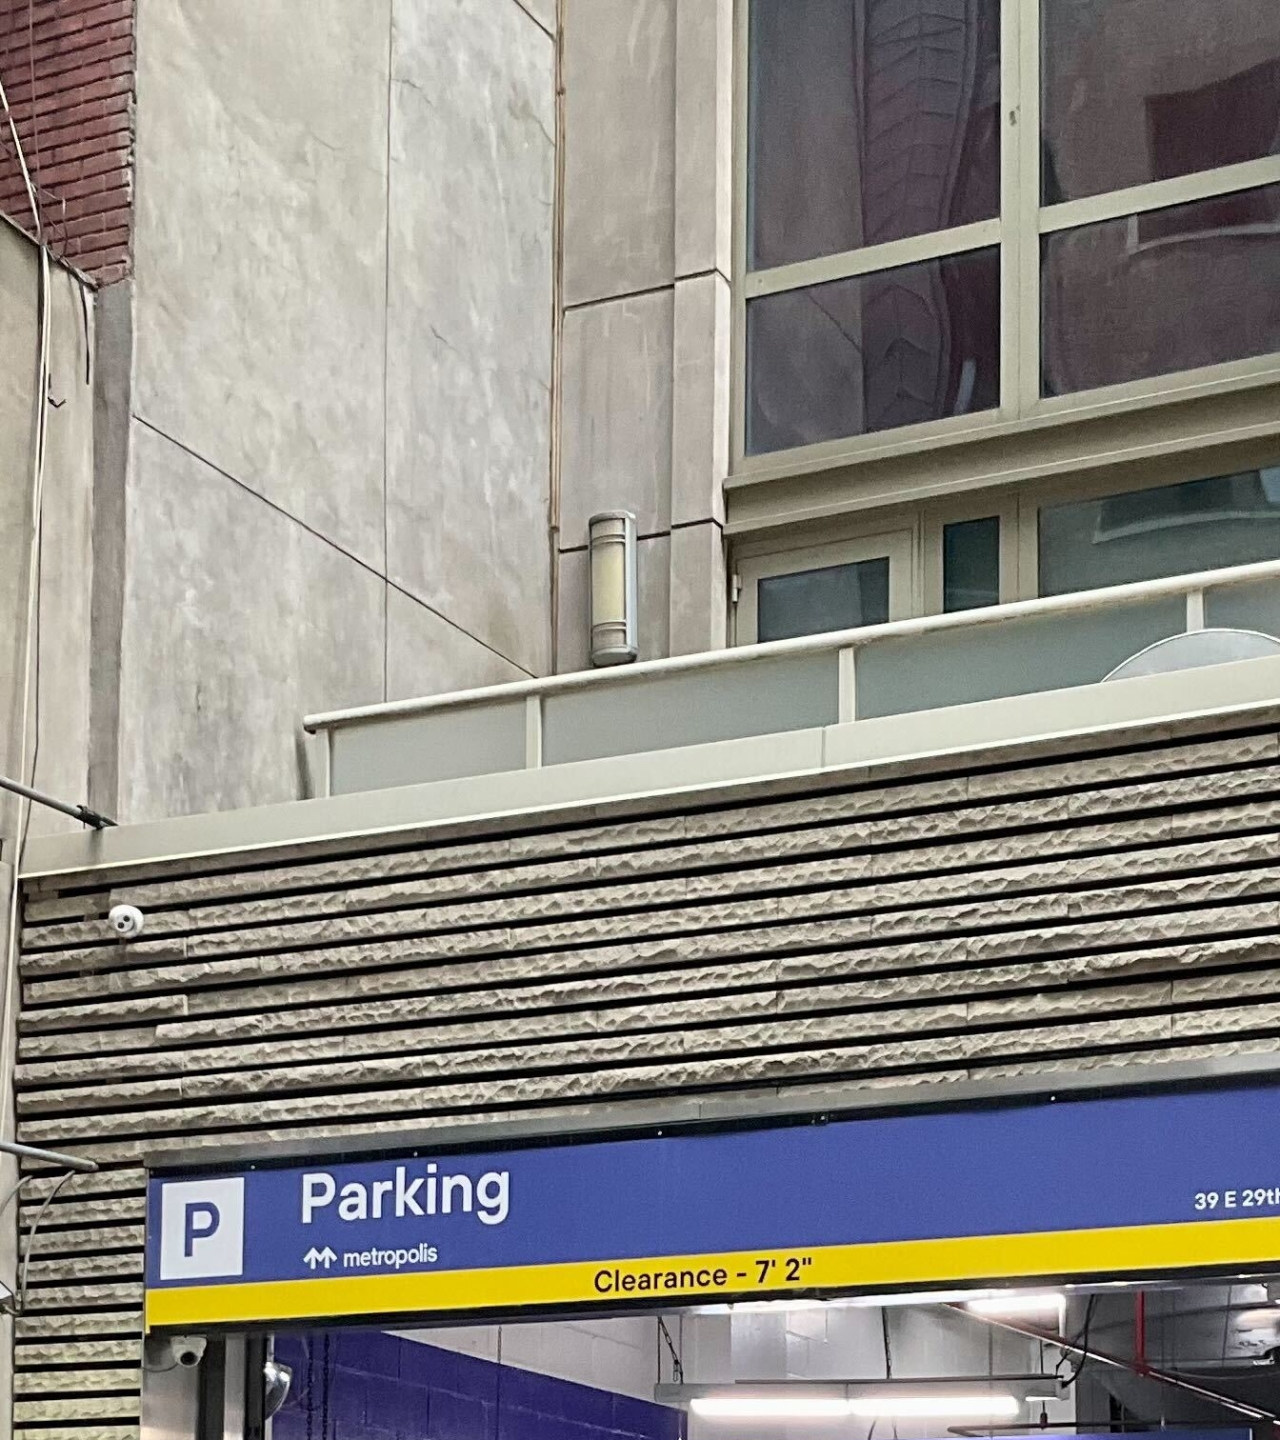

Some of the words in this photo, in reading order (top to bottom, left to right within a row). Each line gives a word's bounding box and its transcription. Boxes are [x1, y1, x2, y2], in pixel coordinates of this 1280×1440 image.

[302, 1163, 509, 1225] Parking
[1194, 1191, 1219, 1210] 39
[1224, 1190, 1237, 1208] E
[184, 1201, 220, 1258] P
[343, 1243, 438, 1269] metropolis
[594, 1268, 727, 1293] Clearance
[755, 1259, 776, 1284] 7'
[785, 1257, 812, 1281] 2"
